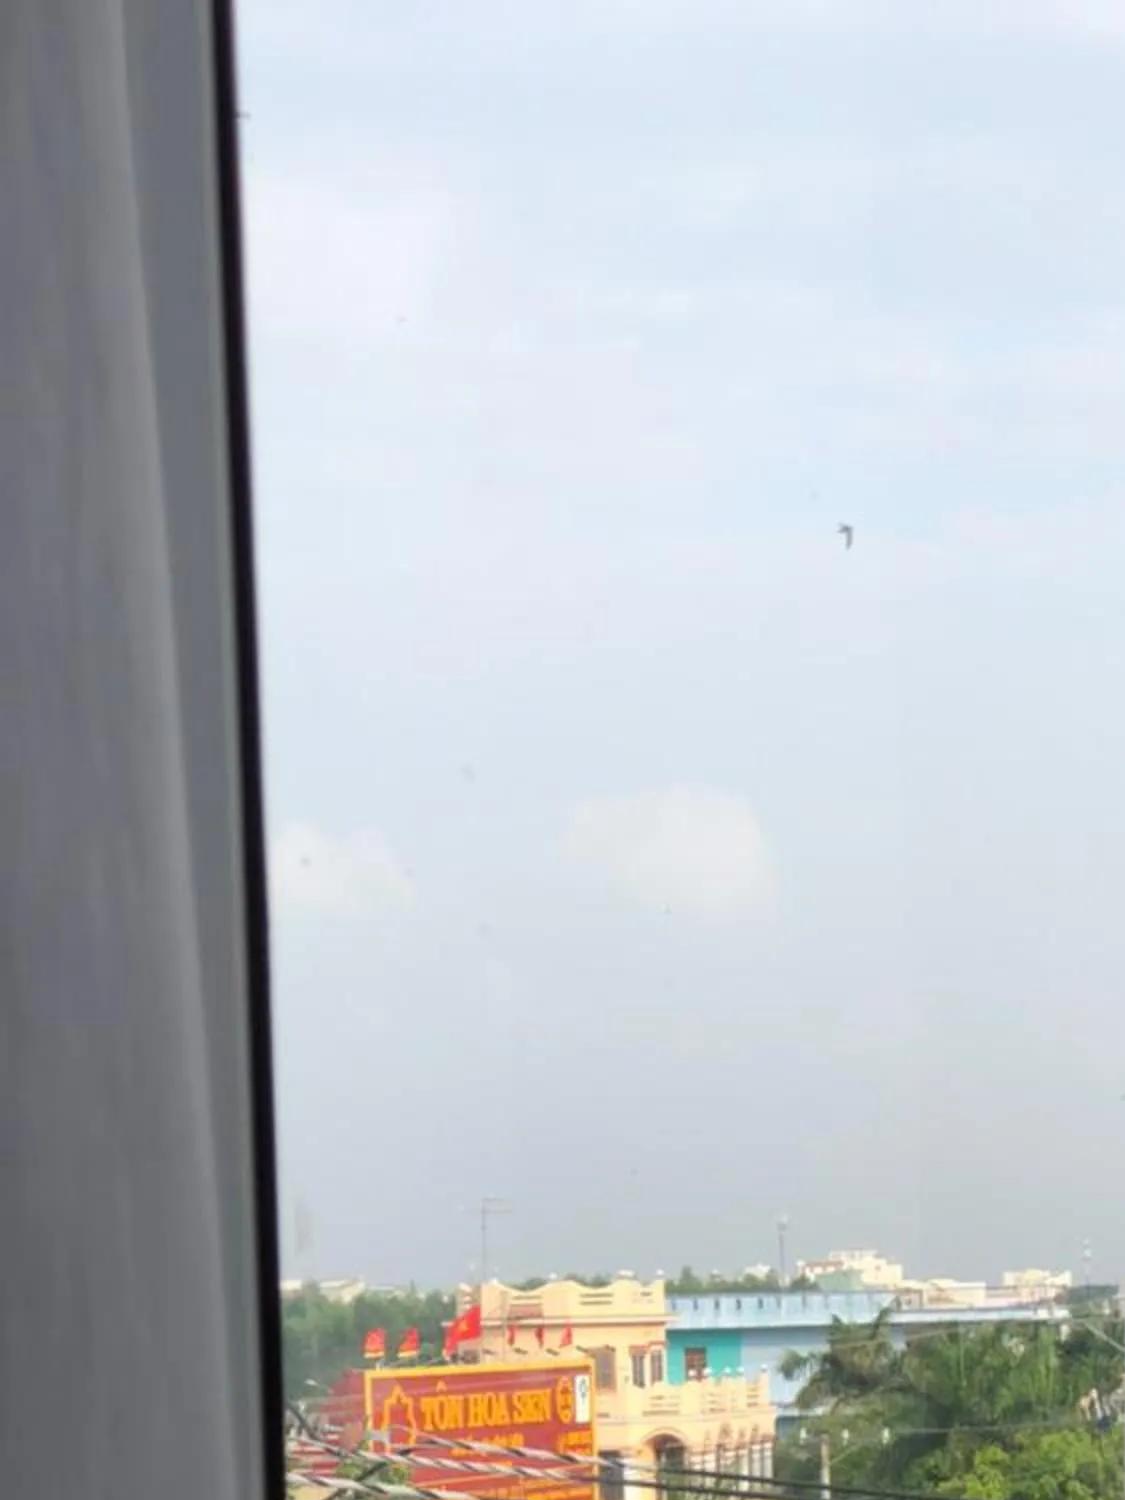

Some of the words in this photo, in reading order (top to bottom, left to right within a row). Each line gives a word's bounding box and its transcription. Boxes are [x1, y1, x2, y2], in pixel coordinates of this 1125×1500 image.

[420, 1380, 464, 1431] TÔN
[467, 1391, 511, 1427] HOA
[512, 1388, 551, 1424] SEN
